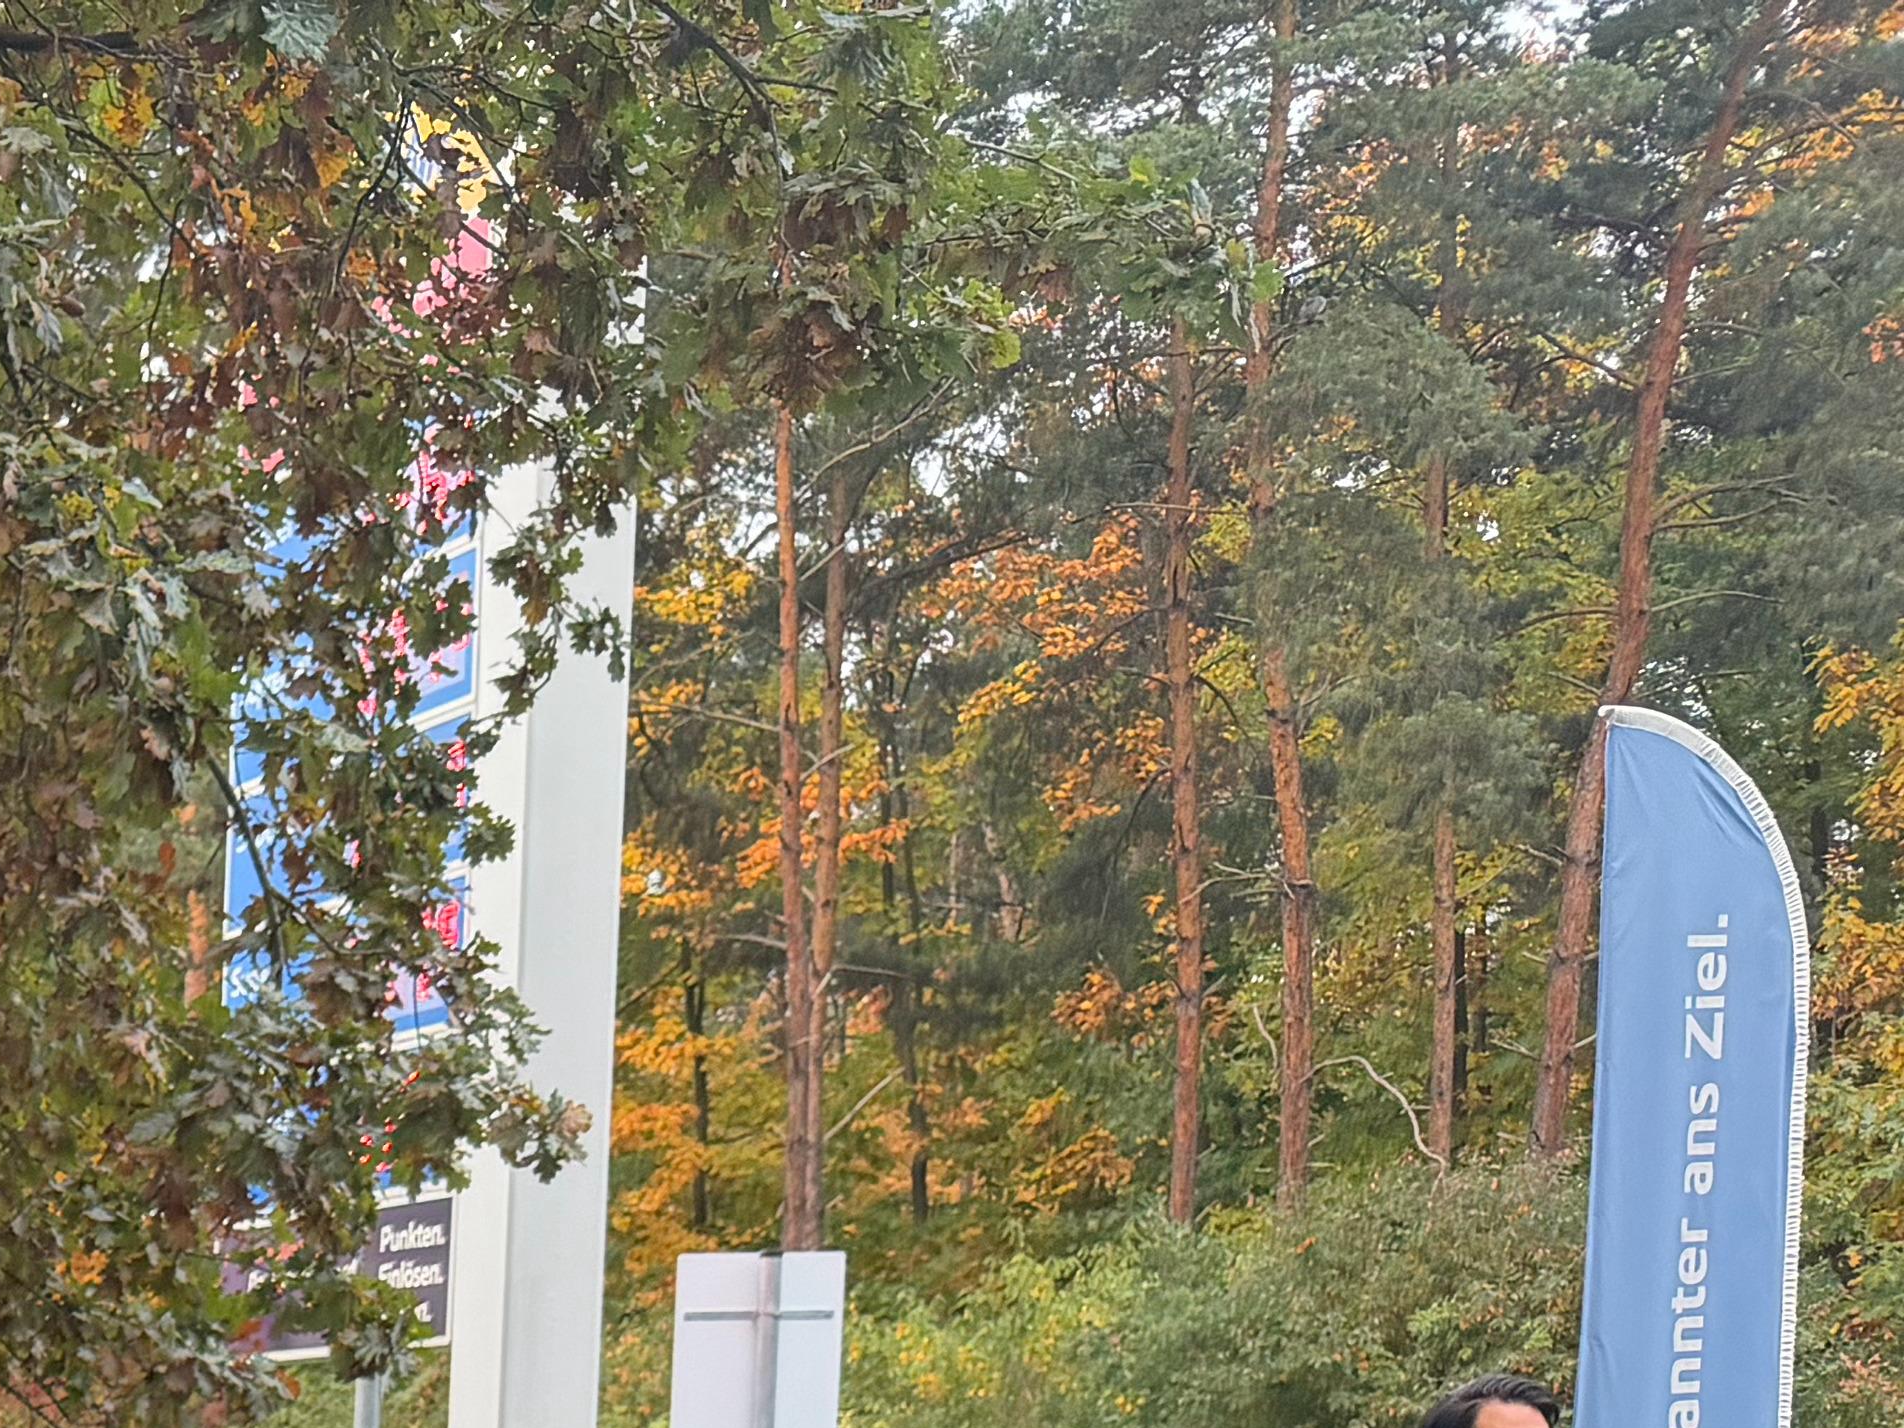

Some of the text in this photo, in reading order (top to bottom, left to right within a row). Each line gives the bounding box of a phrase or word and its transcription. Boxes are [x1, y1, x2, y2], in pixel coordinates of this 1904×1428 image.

[1683, 913, 1730, 1061] Ziel.
[1682, 1081, 1722, 1195] ans
[379, 1221, 446, 1253] Punkten.
